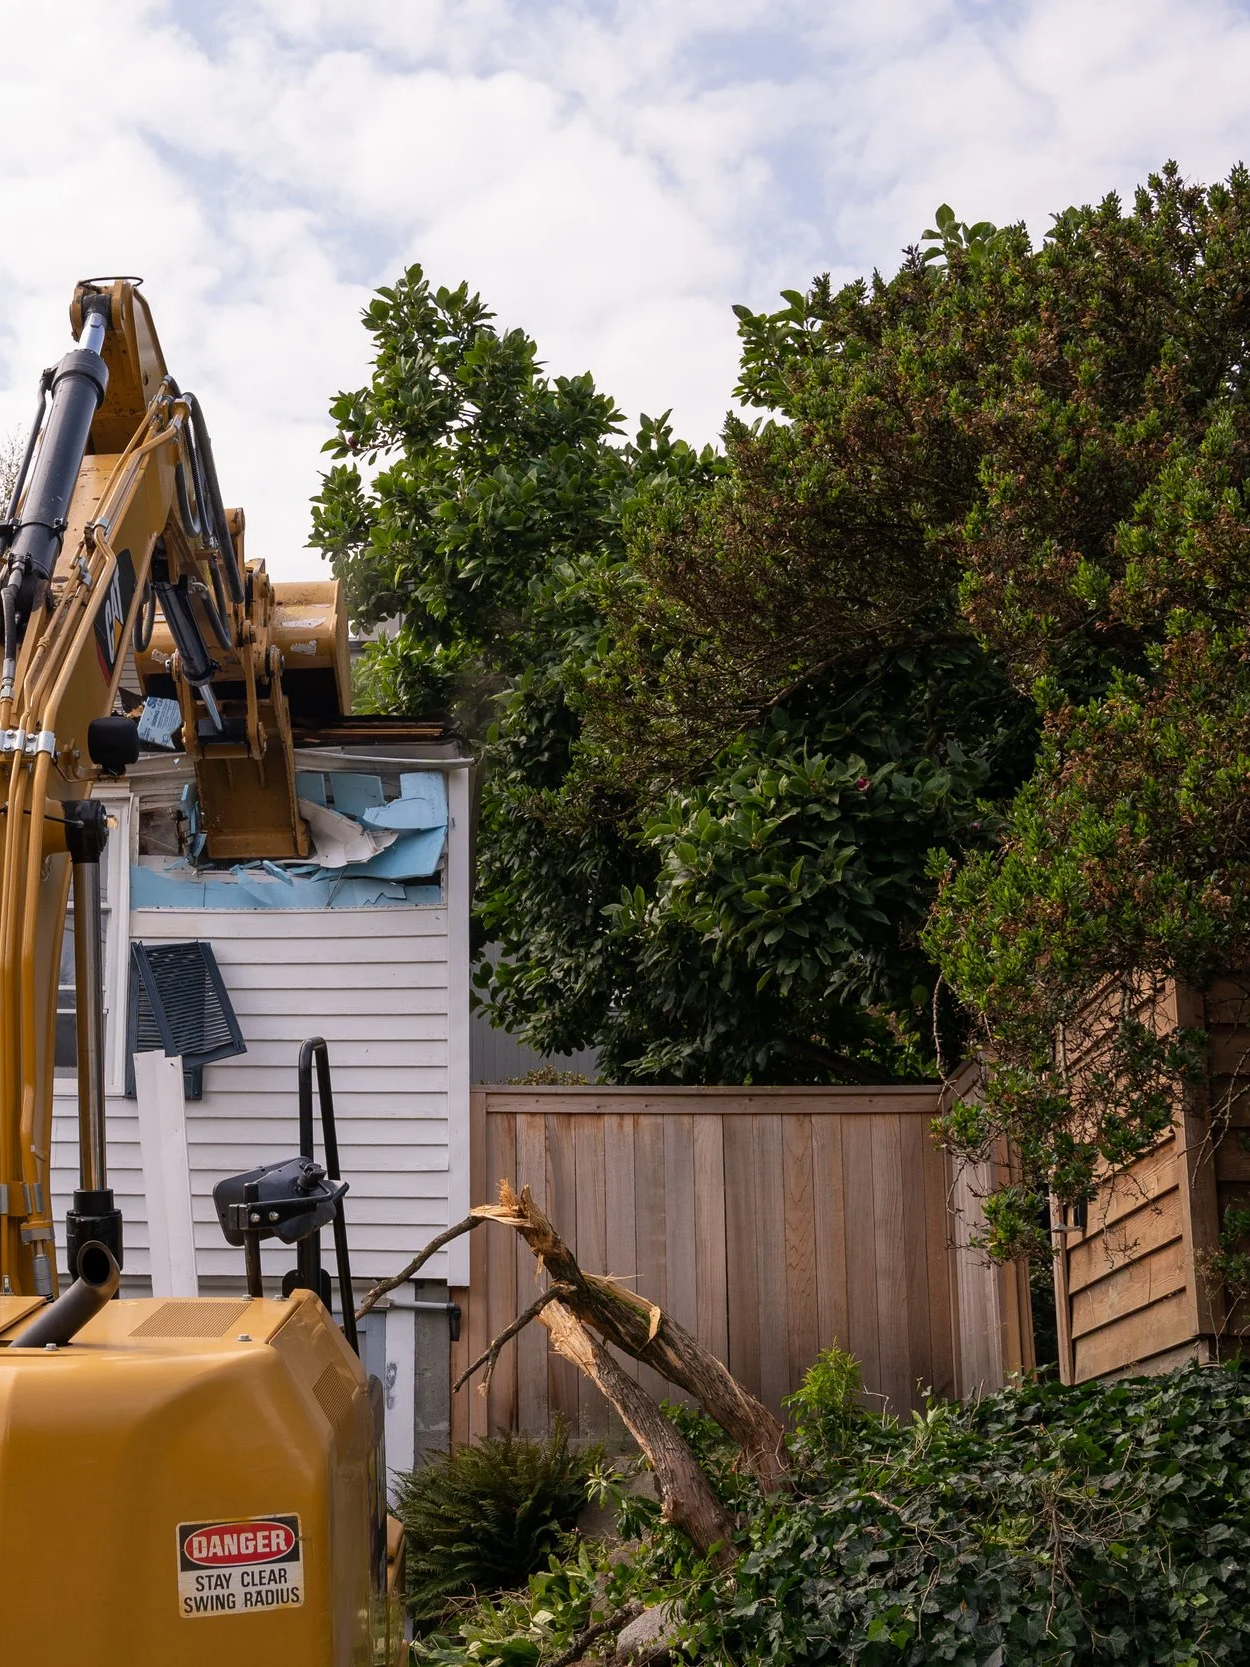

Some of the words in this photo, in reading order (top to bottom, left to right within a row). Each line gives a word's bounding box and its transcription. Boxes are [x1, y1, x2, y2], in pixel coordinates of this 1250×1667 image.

[192, 1529, 288, 1559] DANGER
[195, 1573, 232, 1592] STAY
[241, 1567, 288, 1588] CLEAR
[183, 1593, 236, 1614] SWING
[244, 1586, 300, 1608] RADIUS
